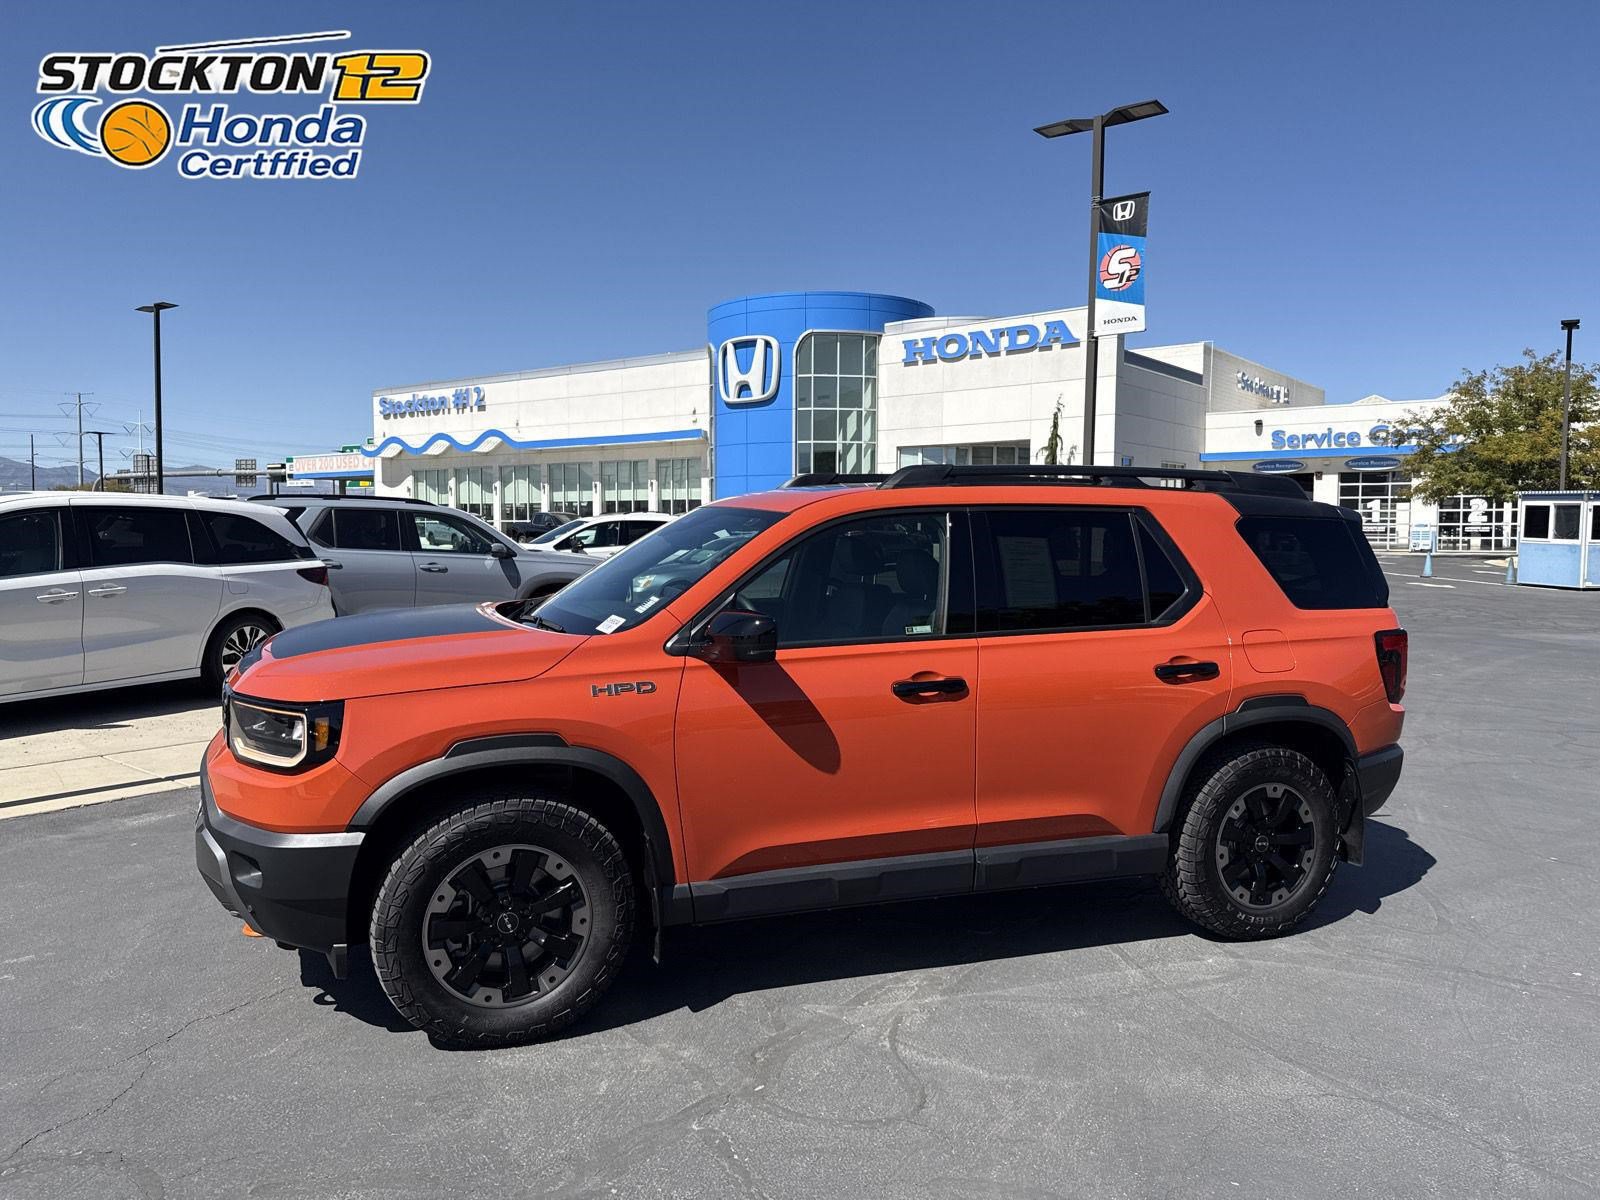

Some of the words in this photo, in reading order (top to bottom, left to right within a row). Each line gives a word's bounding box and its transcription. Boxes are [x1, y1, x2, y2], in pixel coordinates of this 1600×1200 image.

[1103, 315, 1138, 325] HONDA
[902, 319, 1080, 365] HONDA
[379, 393, 450, 418] Stockton
[1271, 428, 1361, 449] Service
[295, 459, 317, 472] OVER
[319, 457, 335, 471] 200
[336, 455, 360, 469] USED
[1367, 499, 1381, 523] 1
[1467, 498, 1489, 523] 2
[590, 680, 657, 698] HPD
